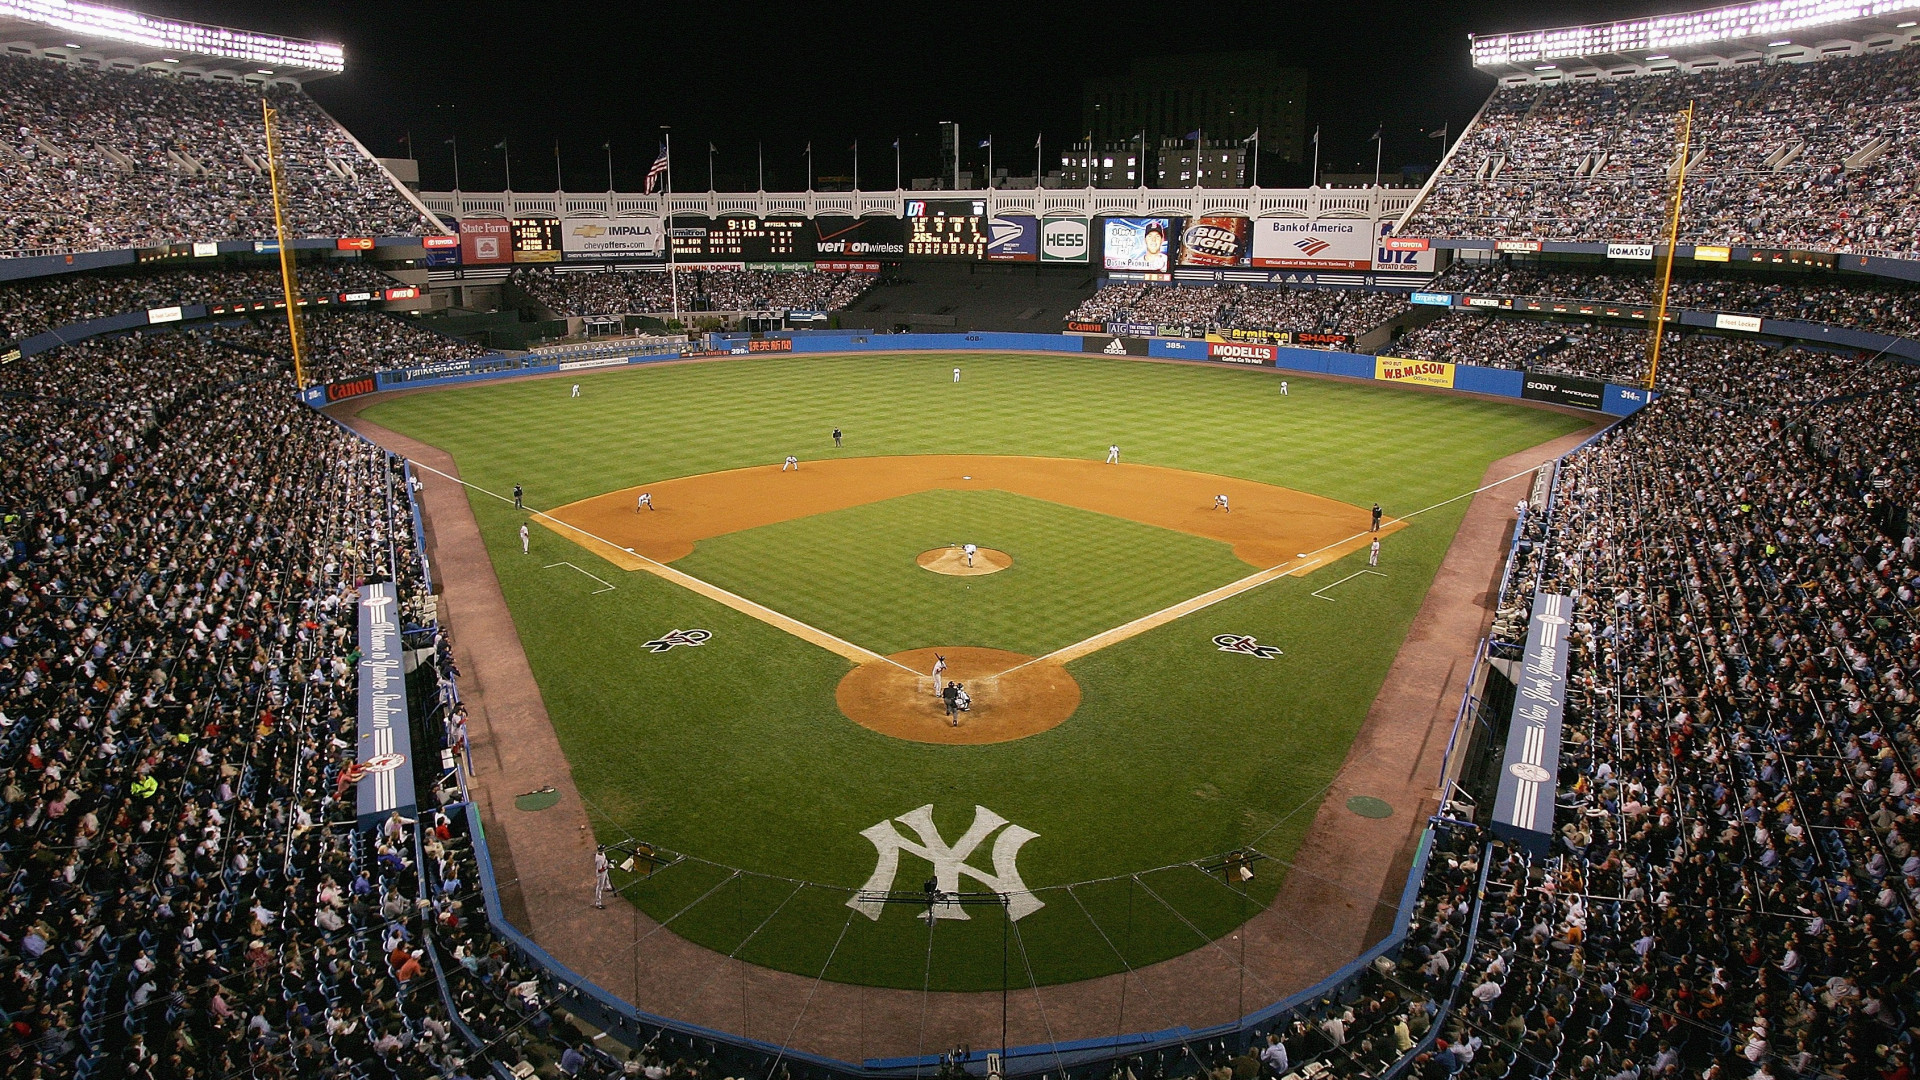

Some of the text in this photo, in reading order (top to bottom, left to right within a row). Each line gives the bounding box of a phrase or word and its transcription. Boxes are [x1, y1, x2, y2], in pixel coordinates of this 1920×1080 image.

[462, 223, 509, 233] State Farm
[728, 220, 756, 230] 9:18
[914, 223, 925, 232] 15
[936, 223, 943, 232] 3
[954, 223, 961, 232] 0
[971, 223, 977, 232] 1
[1273, 222, 1353, 233] Bank of America
[608, 227, 651, 235] IMPALA
[1195, 228, 1236, 242] BUD
[1046, 233, 1083, 246] HESS
[1187, 235, 1238, 253] LIGHT
[584, 241, 645, 250] chevyoffers.com
[1497, 241, 1538, 250] MODELL'S
[1609, 247, 1650, 256] KOMATSU
[392, 290, 407, 298] AVIS
[1068, 321, 1102, 332] Canon
[1110, 324, 1127, 333] AIG
[1232, 329, 1289, 339] Armitron
[1298, 333, 1346, 342] SHARP
[1213, 345, 1271, 359] MODELL'S
[328, 378, 373, 400] Canon
[1527, 381, 1557, 392] SONY
[1562, 389, 1599, 398] HANDYCAM
[371, 621, 395, 651] Welcome
[371, 652, 390, 660] to
[361, 660, 399, 690] Yankee
[1519, 646, 1562, 729] New York Yankees
[372, 690, 401, 728] Stadium
[845, 804, 1045, 922] NY
